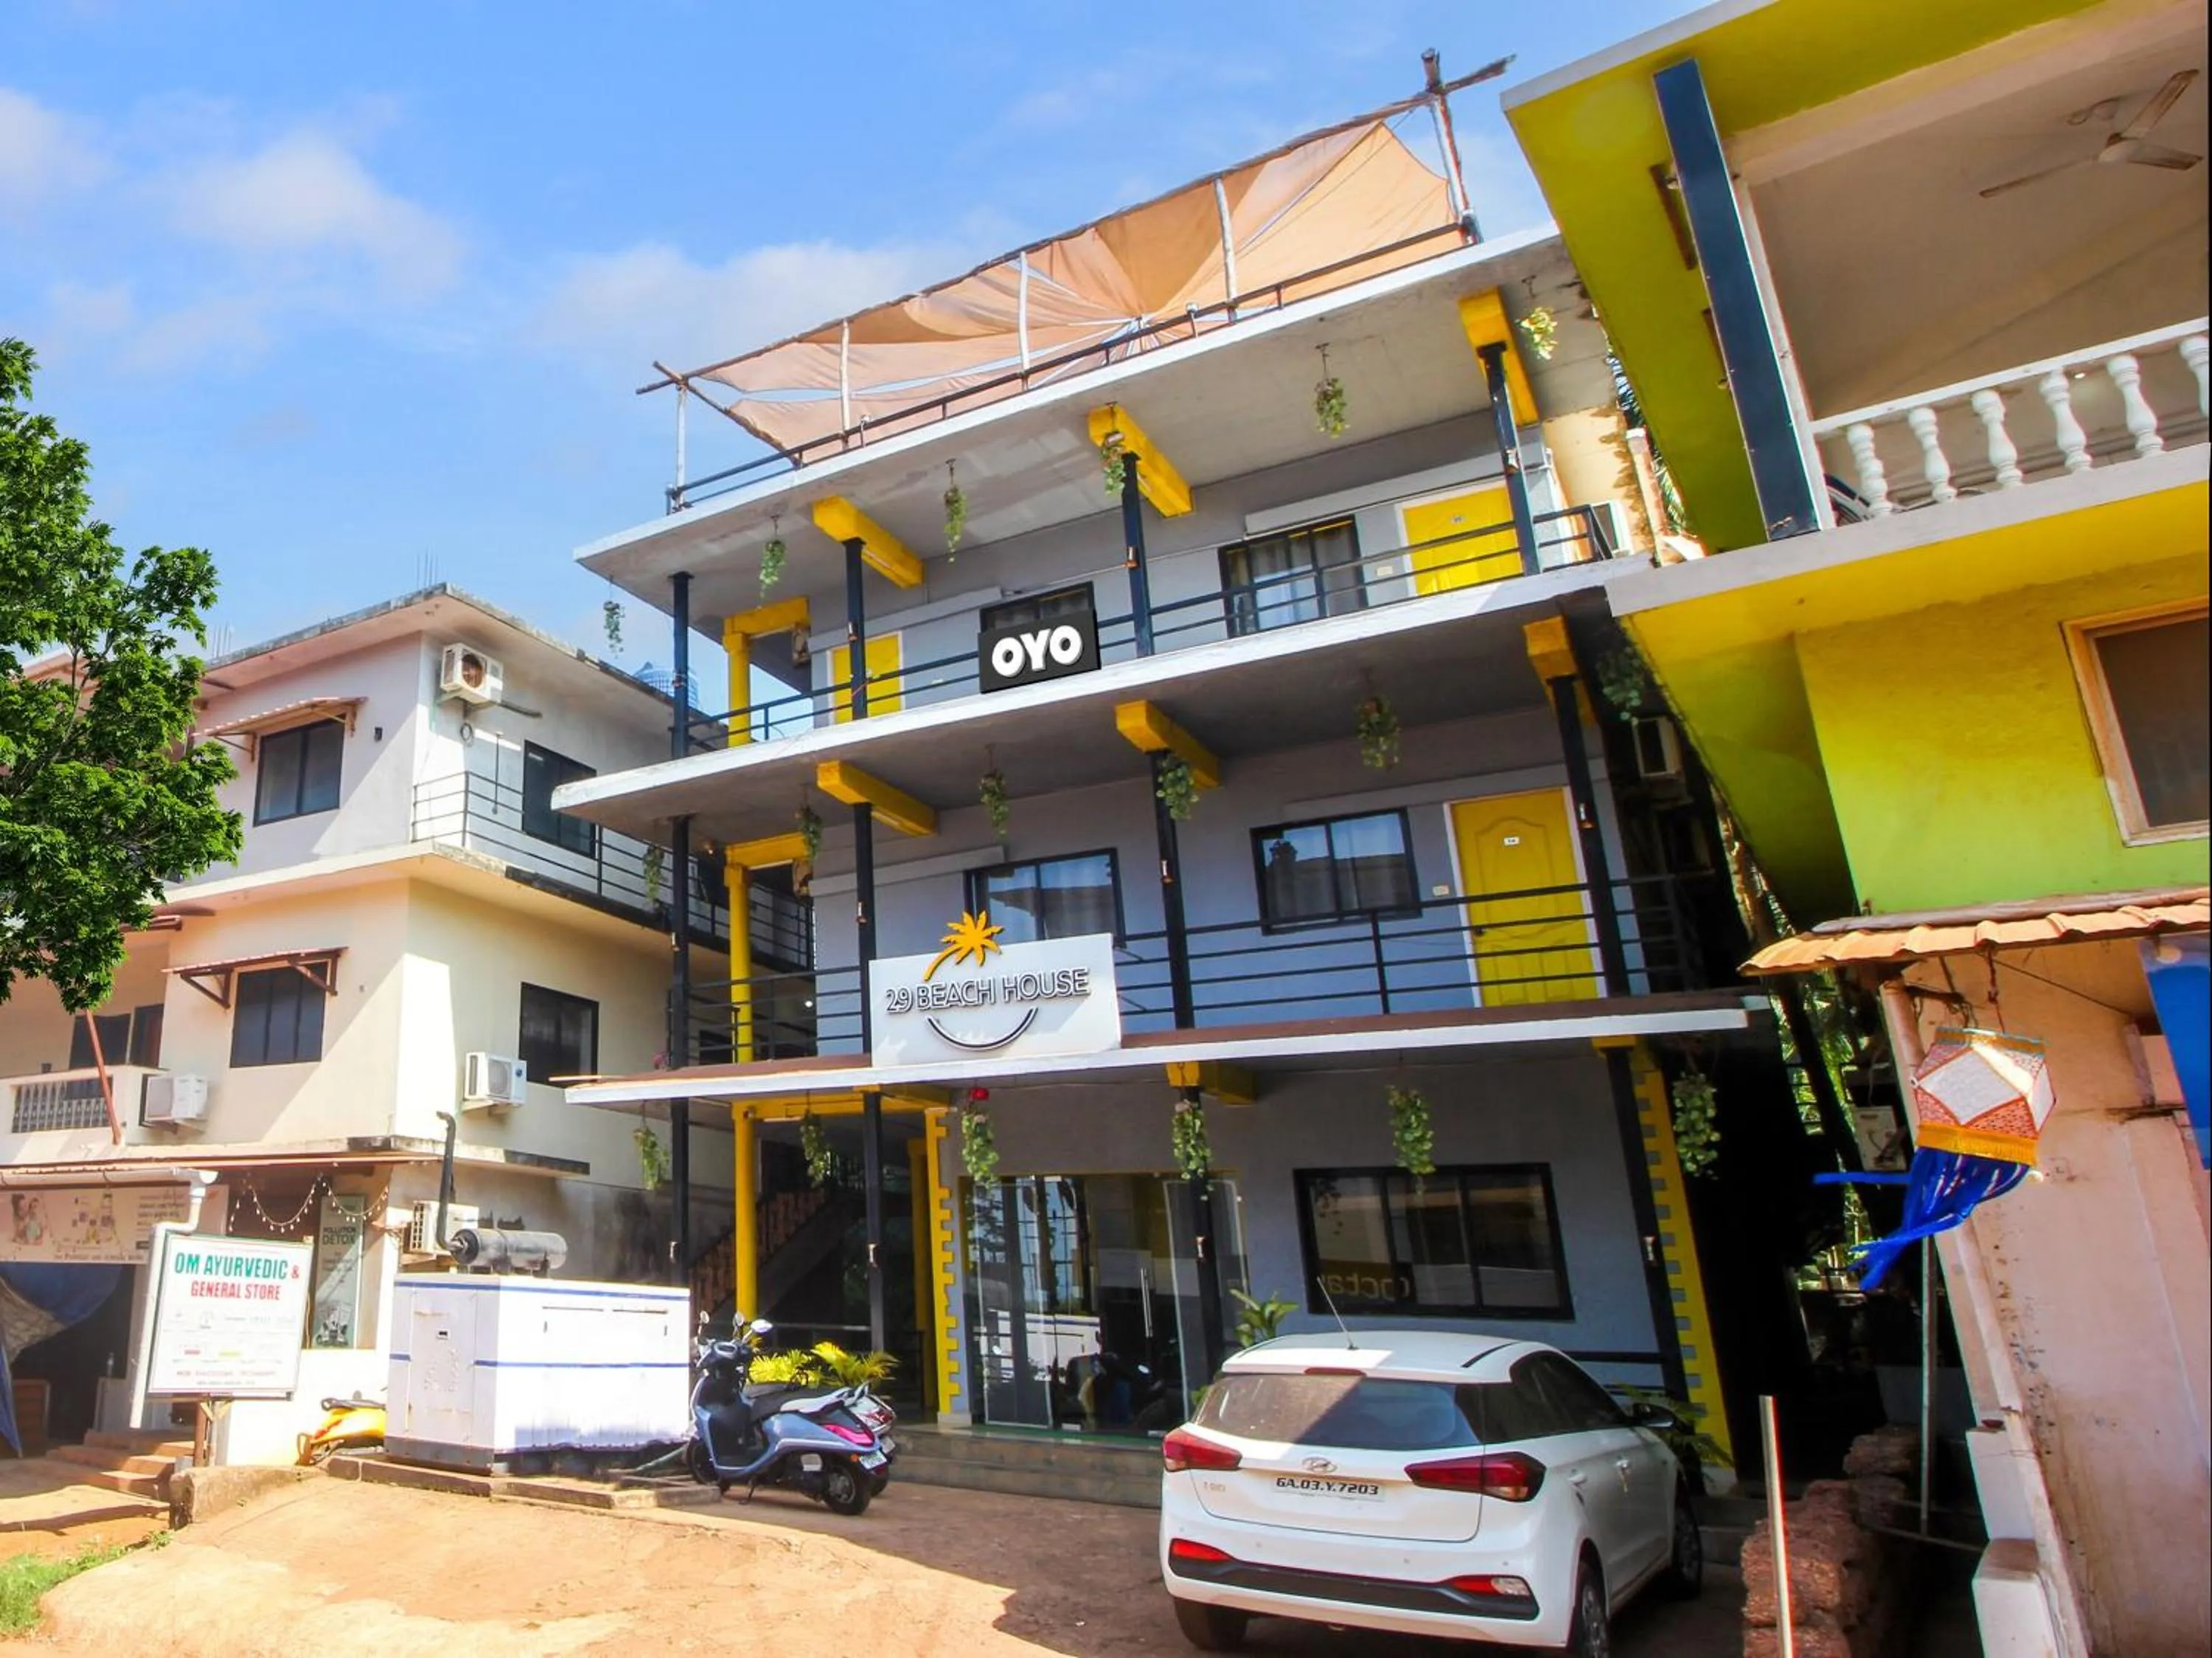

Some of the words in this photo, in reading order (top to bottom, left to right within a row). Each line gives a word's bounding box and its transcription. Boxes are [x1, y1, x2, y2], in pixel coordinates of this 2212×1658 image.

[992, 625, 1083, 678] OYO
[886, 985, 914, 1014] 29
[916, 977, 996, 1011] BEACH
[1001, 967, 1091, 1004] HOUSE
[322, 1234, 355, 1245] DETOX
[174, 1252, 201, 1274] OM
[204, 1255, 288, 1280] AYURVEDIC
[291, 1264, 299, 1279] &
[191, 1280, 241, 1299] GENERAL
[244, 1283, 282, 1300] STORE
